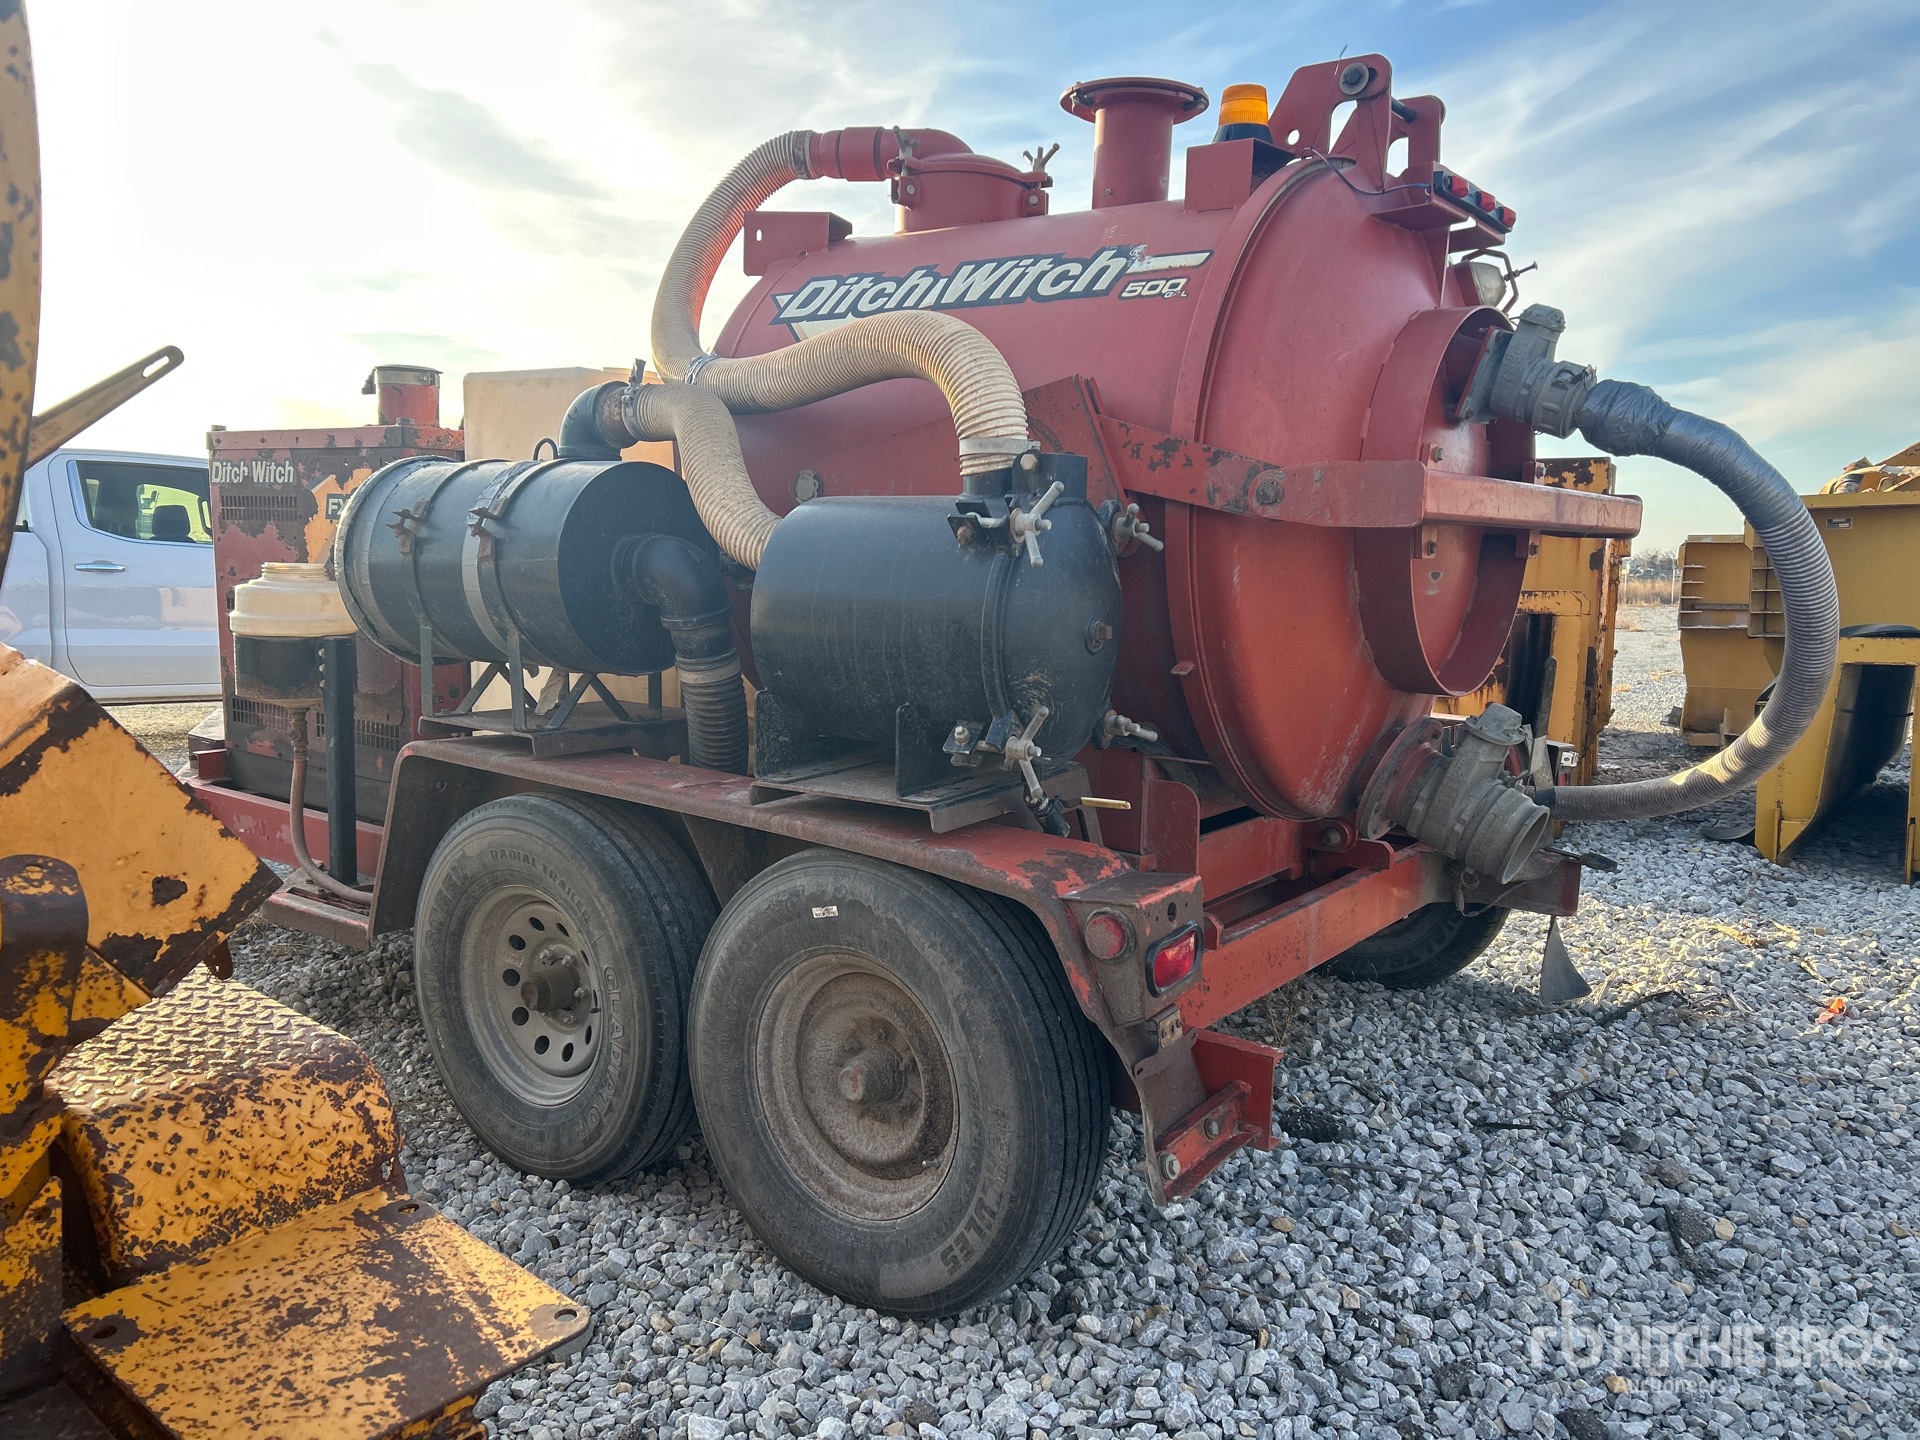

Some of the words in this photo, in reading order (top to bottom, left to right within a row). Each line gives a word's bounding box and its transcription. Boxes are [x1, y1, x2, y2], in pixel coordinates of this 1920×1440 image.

[778, 269, 936, 320] Ditch
[942, 249, 1127, 304] Witch
[1121, 278, 1188, 298] 500
[211, 460, 249, 484] Ditch
[251, 460, 294, 484] Witch
[489, 848, 539, 870] RADIAL
[573, 966, 626, 1142] GLADIATOR
